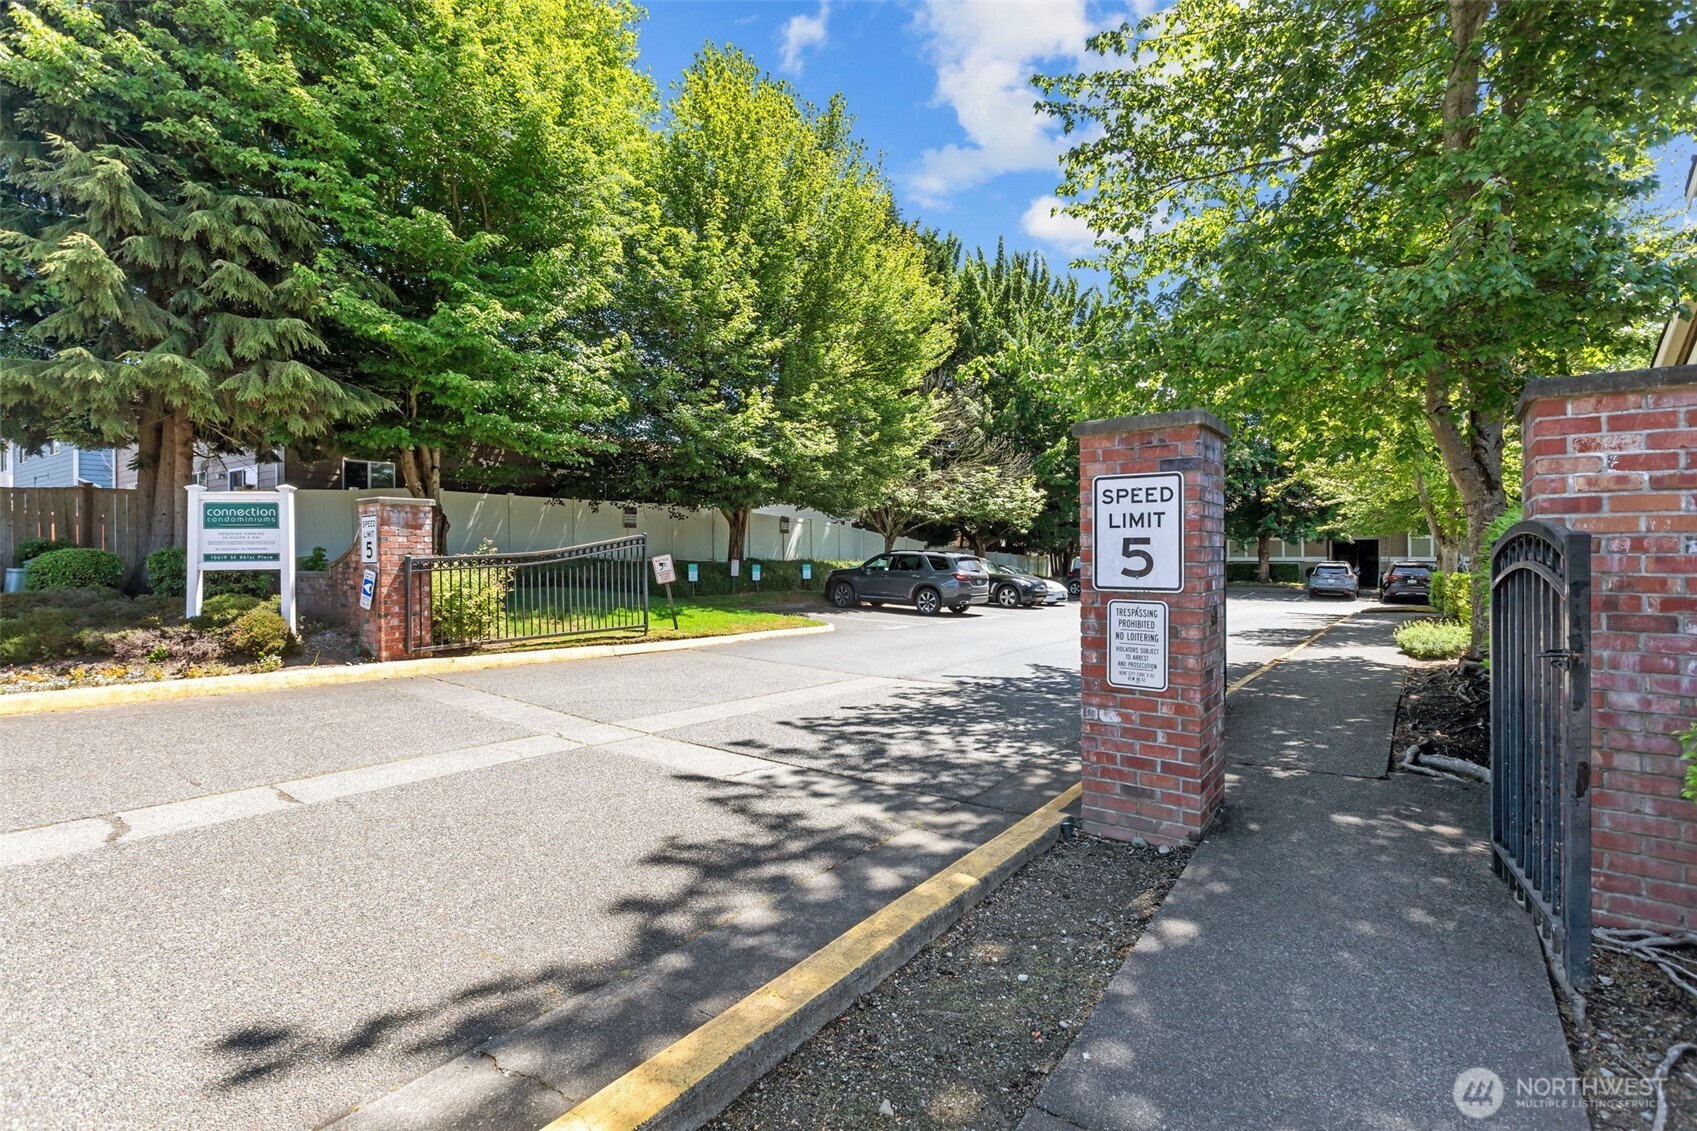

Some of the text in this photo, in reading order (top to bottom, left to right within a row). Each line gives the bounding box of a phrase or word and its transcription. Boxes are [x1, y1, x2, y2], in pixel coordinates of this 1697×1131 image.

[1102, 486, 1174, 504] SPEED
[206, 507, 276, 517] connection
[362, 520, 376, 528] SPEED
[1109, 512, 1166, 529] LIMIT
[363, 530, 375, 539] LIMIT
[366, 541, 373, 559] 5
[1120, 537, 1154, 578] 5
[1116, 607, 1158, 618] TRESPASSING
[1118, 619, 1155, 629] PROHIBITED
[1115, 632, 1159, 643] NO LOITERING
[1116, 646, 1138, 654] VIOLATORS
